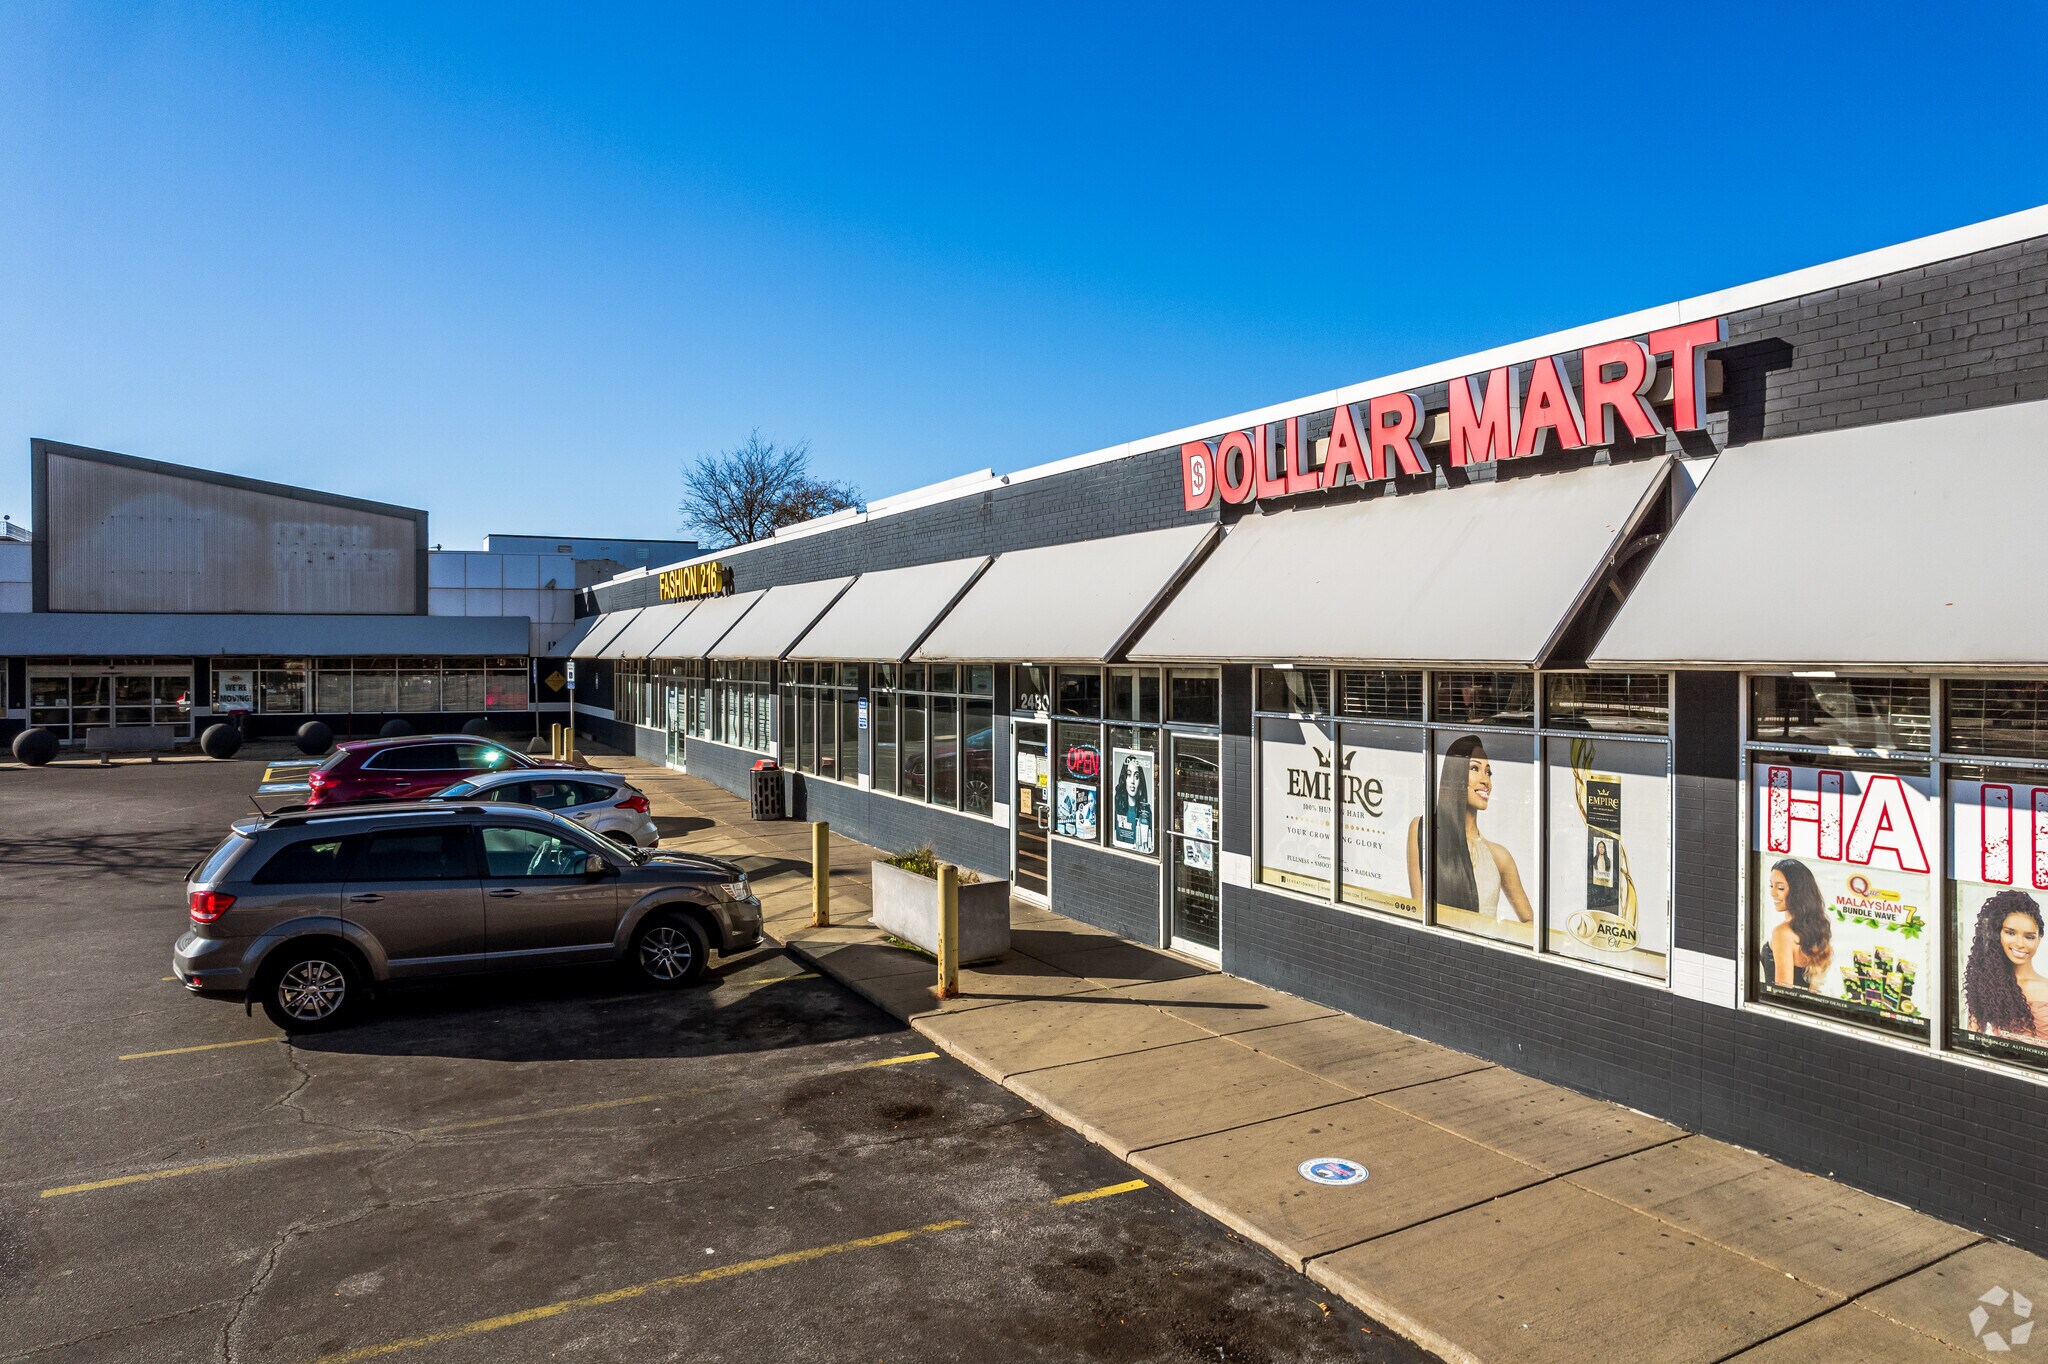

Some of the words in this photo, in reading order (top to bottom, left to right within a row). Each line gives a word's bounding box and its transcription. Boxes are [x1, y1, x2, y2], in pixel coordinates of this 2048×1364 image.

[1180, 391, 1427, 511] DOLLAR
[1448, 318, 1722, 467] MART
[660, 565, 698, 600] FASHION
[700, 561, 719, 594] 216
[225, 683, 248, 691] WE'RE
[220, 694, 252, 703] MOVING!
[1020, 692, 1050, 711] 2480
[1067, 747, 1099, 776] OPEN
[1346, 809, 1365, 819] HAIR
[1767, 765, 2048, 890] HAI
[1287, 826, 1307, 836] YOUR
[1309, 830, 1353, 845] CROWNG
[1355, 838, 1383, 850] GLORY
[1286, 854, 1310, 865] FULLNESS
[1314, 860, 1350, 873] SMOOSS
[1355, 868, 1382, 879] RADIANCE
[1842, 906, 1872, 918] BUNDLE
[1874, 911, 1896, 921] WAVE
[1903, 905, 1917, 924] 7
[1597, 923, 1637, 941] ARGAN
[1829, 1001, 1848, 1009] DEALER
